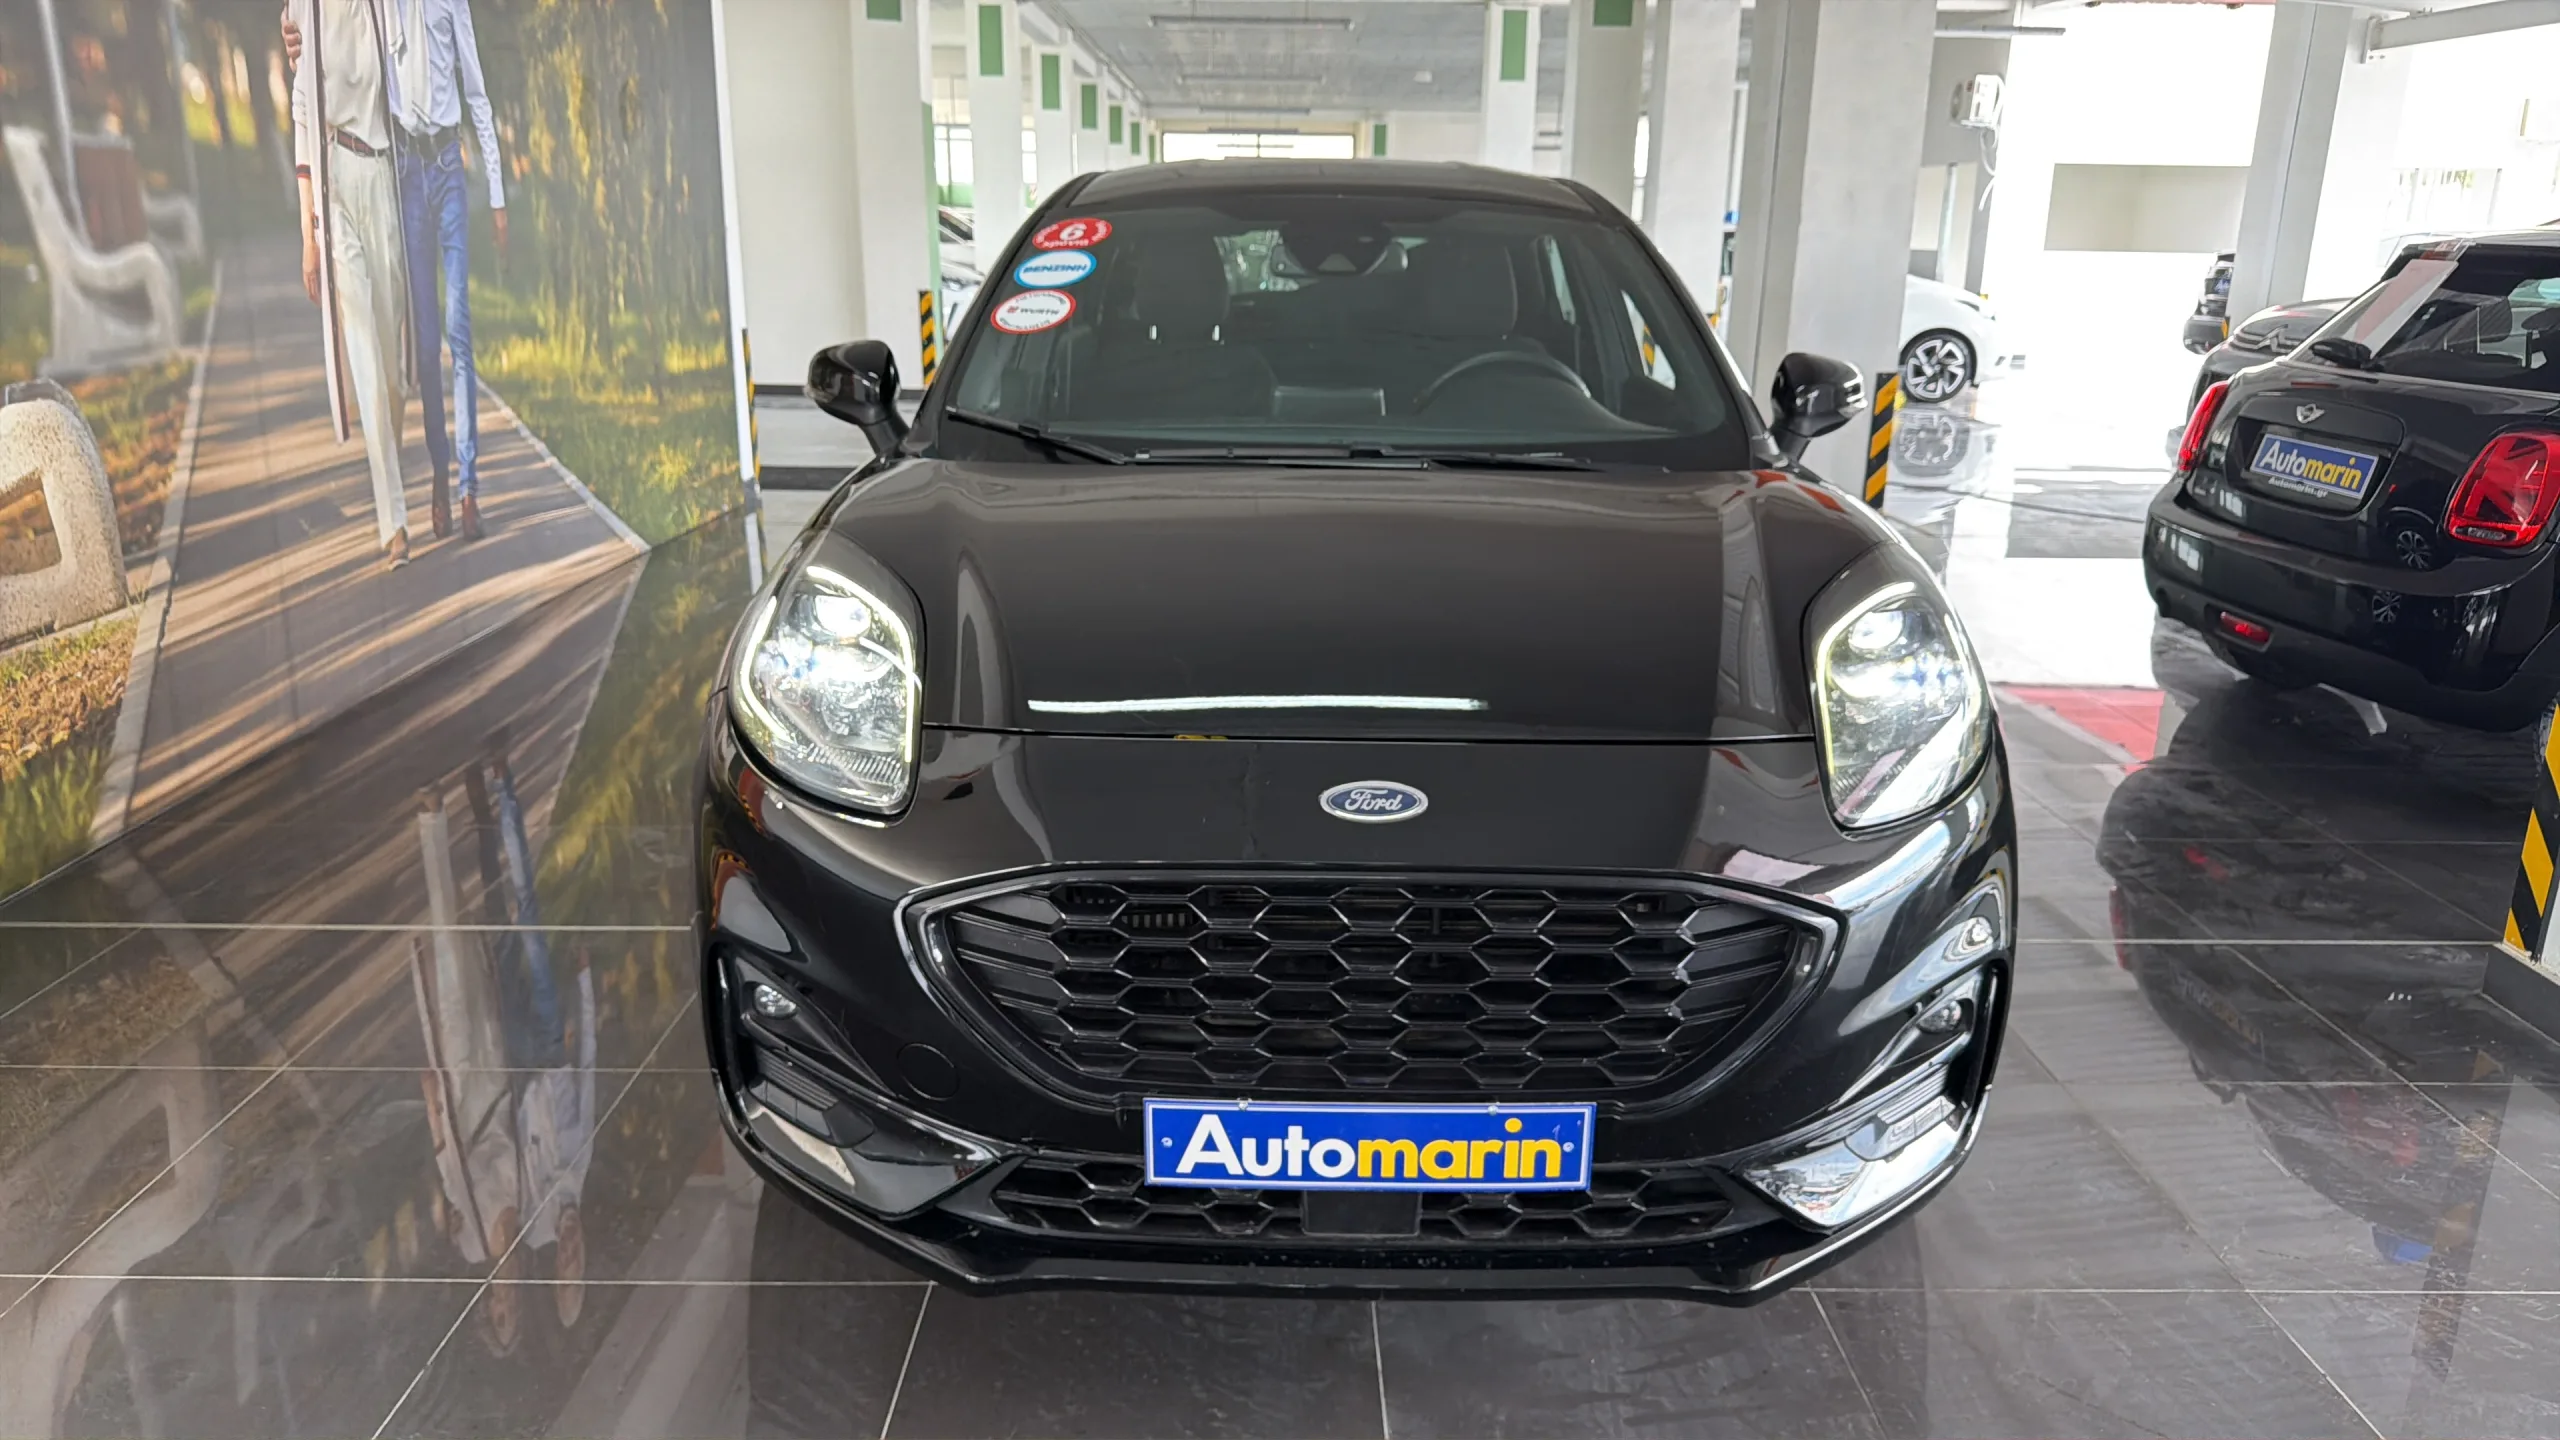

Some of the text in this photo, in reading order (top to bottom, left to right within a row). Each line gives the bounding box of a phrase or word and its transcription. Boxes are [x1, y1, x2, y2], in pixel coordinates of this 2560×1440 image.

[1060, 224, 1087, 241] 6
[2259, 441, 2361, 489] Automarin
[1344, 788, 1402, 811] Ford
[1175, 1114, 1561, 1179] Automarin
